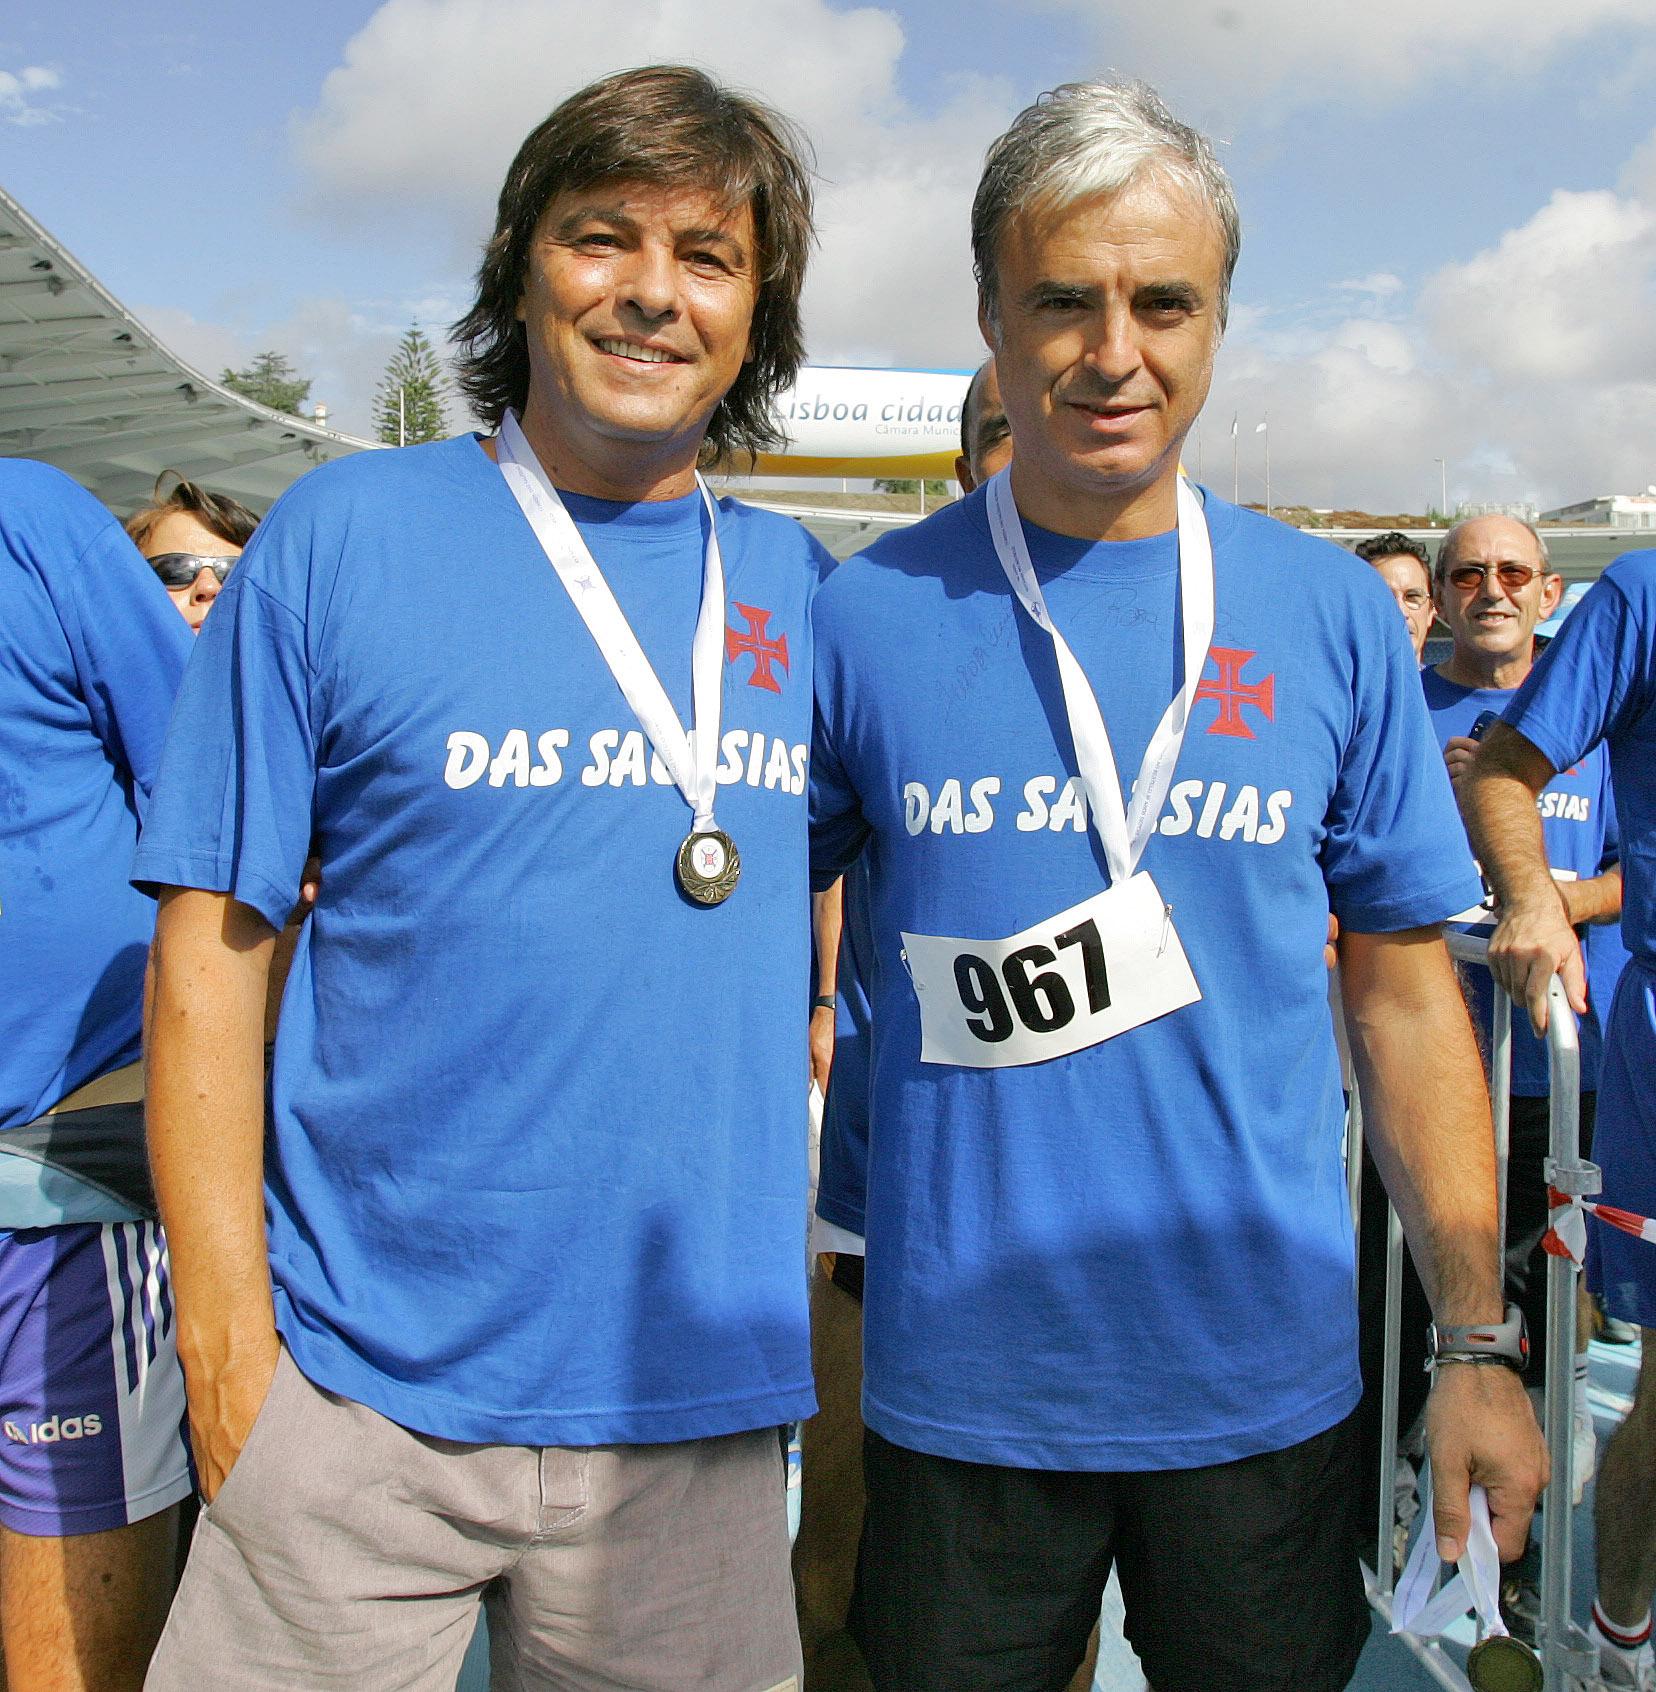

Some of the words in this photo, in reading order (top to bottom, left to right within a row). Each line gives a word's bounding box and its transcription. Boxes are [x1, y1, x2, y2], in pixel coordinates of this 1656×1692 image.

[444, 729, 569, 790] DAS
[581, 729, 808, 796] SASIAS
[903, 776, 1001, 837] DAS
[1016, 775, 1293, 845] SASIAS
[1536, 792, 1590, 822] SIAS
[953, 917, 1112, 1043] 967
